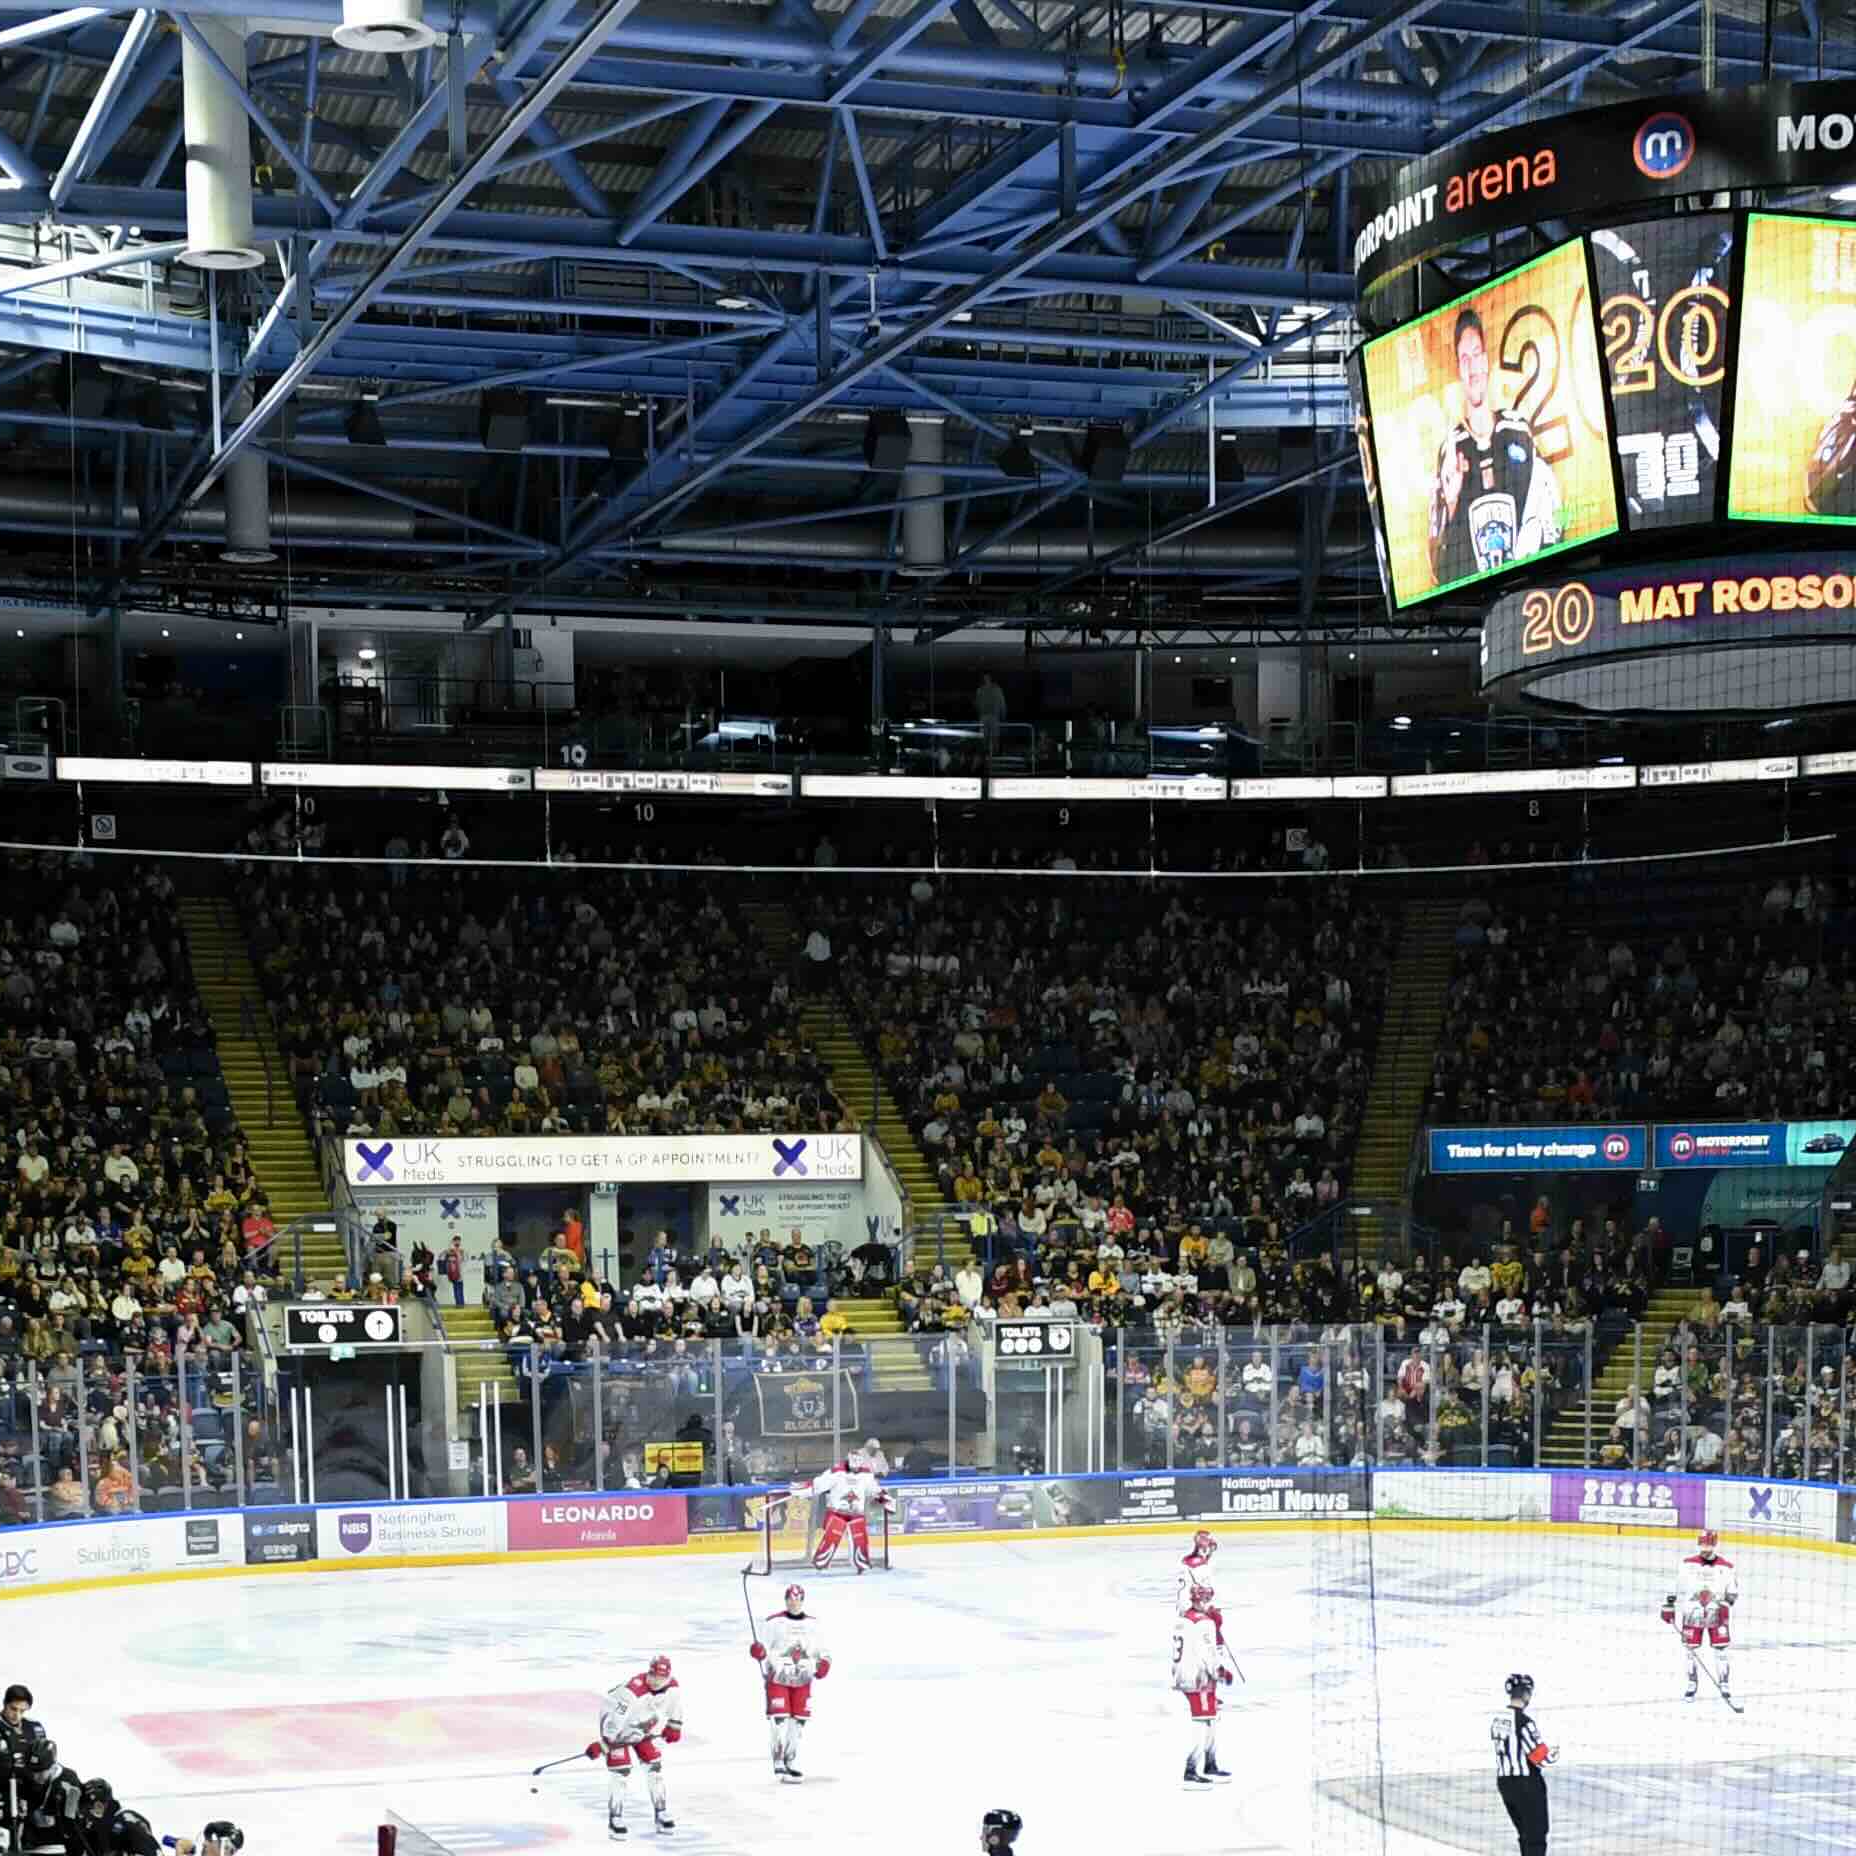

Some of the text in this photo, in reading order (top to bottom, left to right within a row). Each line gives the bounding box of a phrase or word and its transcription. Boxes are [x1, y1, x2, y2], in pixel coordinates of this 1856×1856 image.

[1446, 150, 1559, 214] arena
[1601, 286, 1732, 396] 20
[1522, 581, 1596, 656] 20
[1620, 582, 1704, 625] MAT
[634, 804, 655, 821] 10
[1528, 800, 1540, 817] 8
[1058, 809, 1070, 826] 9
[1696, 1135, 1771, 1147] MOTORPOINT
[402, 1141, 442, 1165] UK
[816, 1138, 854, 1162] UK
[1447, 1144, 1482, 1158] Time
[1484, 1142, 1505, 1157] for
[1506, 1146, 1517, 1157] a
[1517, 1143, 1543, 1160] key
[1544, 1142, 1597, 1159] change
[457, 1153, 552, 1169] STRUGGLING
[559, 1154, 577, 1169] TO
[581, 1152, 609, 1168] GET
[628, 1152, 649, 1167] GP
[403, 1167, 446, 1182] Meds
[816, 1163, 856, 1177] Meds
[299, 1310, 355, 1324] TOILETS
[1000, 1326, 1042, 1338] TOILETS
[1222, 1477, 1294, 1491] Nottingham
[1222, 1490, 1350, 1513] Local News
[1776, 1488, 1801, 1509] UK
[378, 1511, 456, 1526] Nottingham
[541, 1504, 655, 1523] LEONARDO
[342, 1522, 369, 1535] NBS
[378, 1525, 486, 1541] Business School
[77, 1542, 152, 1565] Solutions
